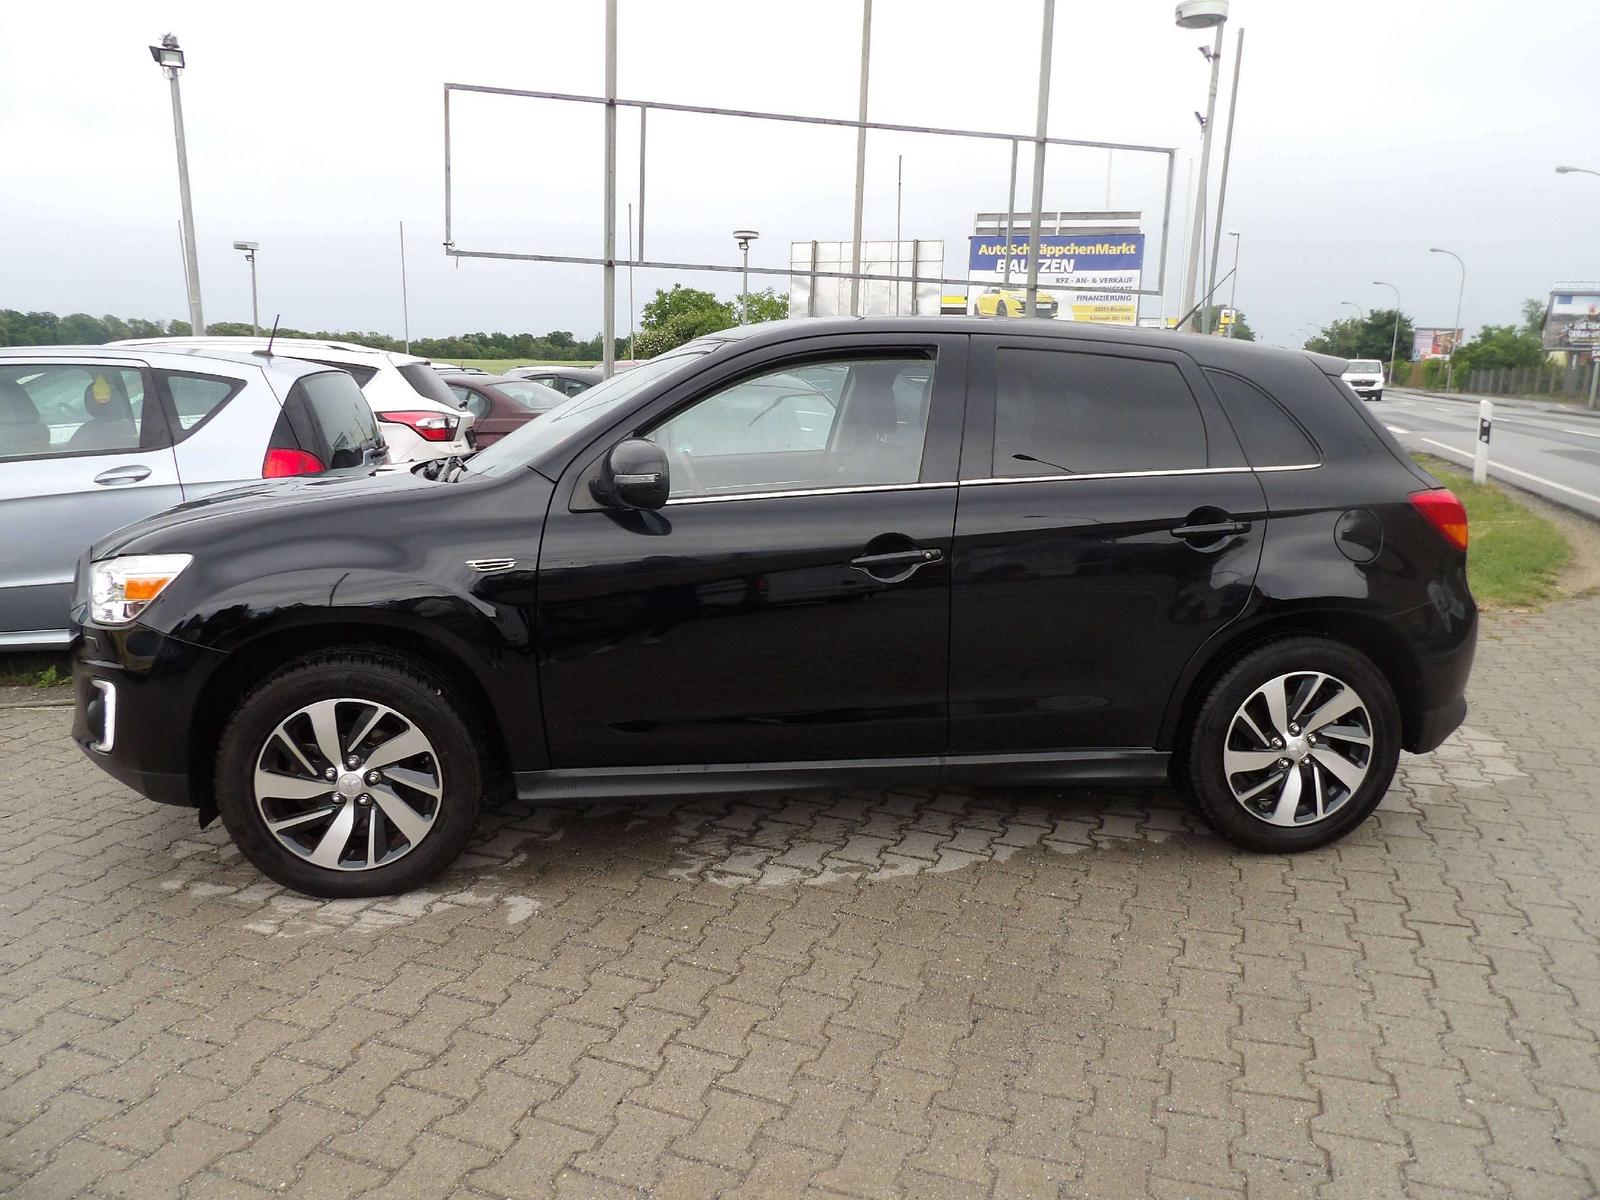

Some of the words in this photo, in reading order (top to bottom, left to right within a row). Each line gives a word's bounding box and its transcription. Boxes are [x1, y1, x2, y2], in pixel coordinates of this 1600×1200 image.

[978, 243, 1136, 257] AutoSchäppchenMarkt
[995, 259, 1075, 273] BAUZEN
[1076, 294, 1132, 302] FINANZIERUNG
